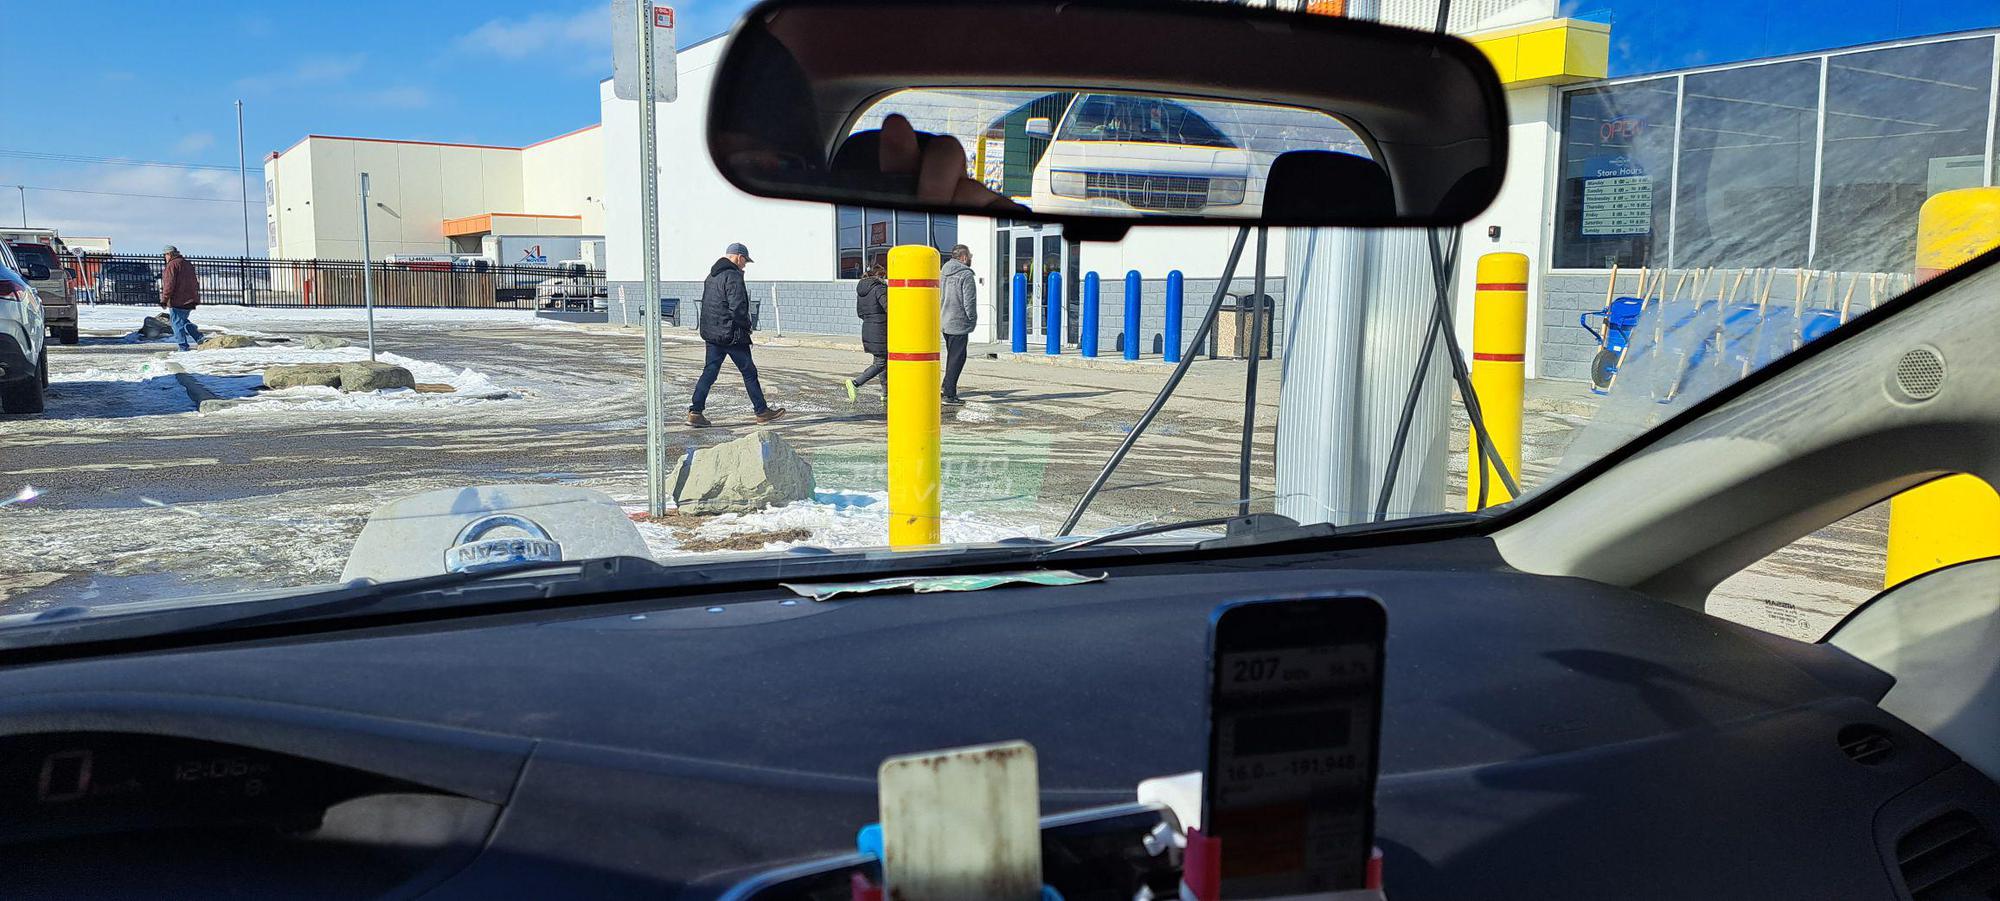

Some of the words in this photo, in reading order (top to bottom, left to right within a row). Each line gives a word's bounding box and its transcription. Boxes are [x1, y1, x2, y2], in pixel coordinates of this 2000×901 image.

[1600, 120, 1645, 140] OPEN
[1597, 168, 1618, 177] Store
[1620, 166, 1642, 175] Hours
[458, 540, 550, 561] NISSAN
[1233, 657, 1280, 682] 207
